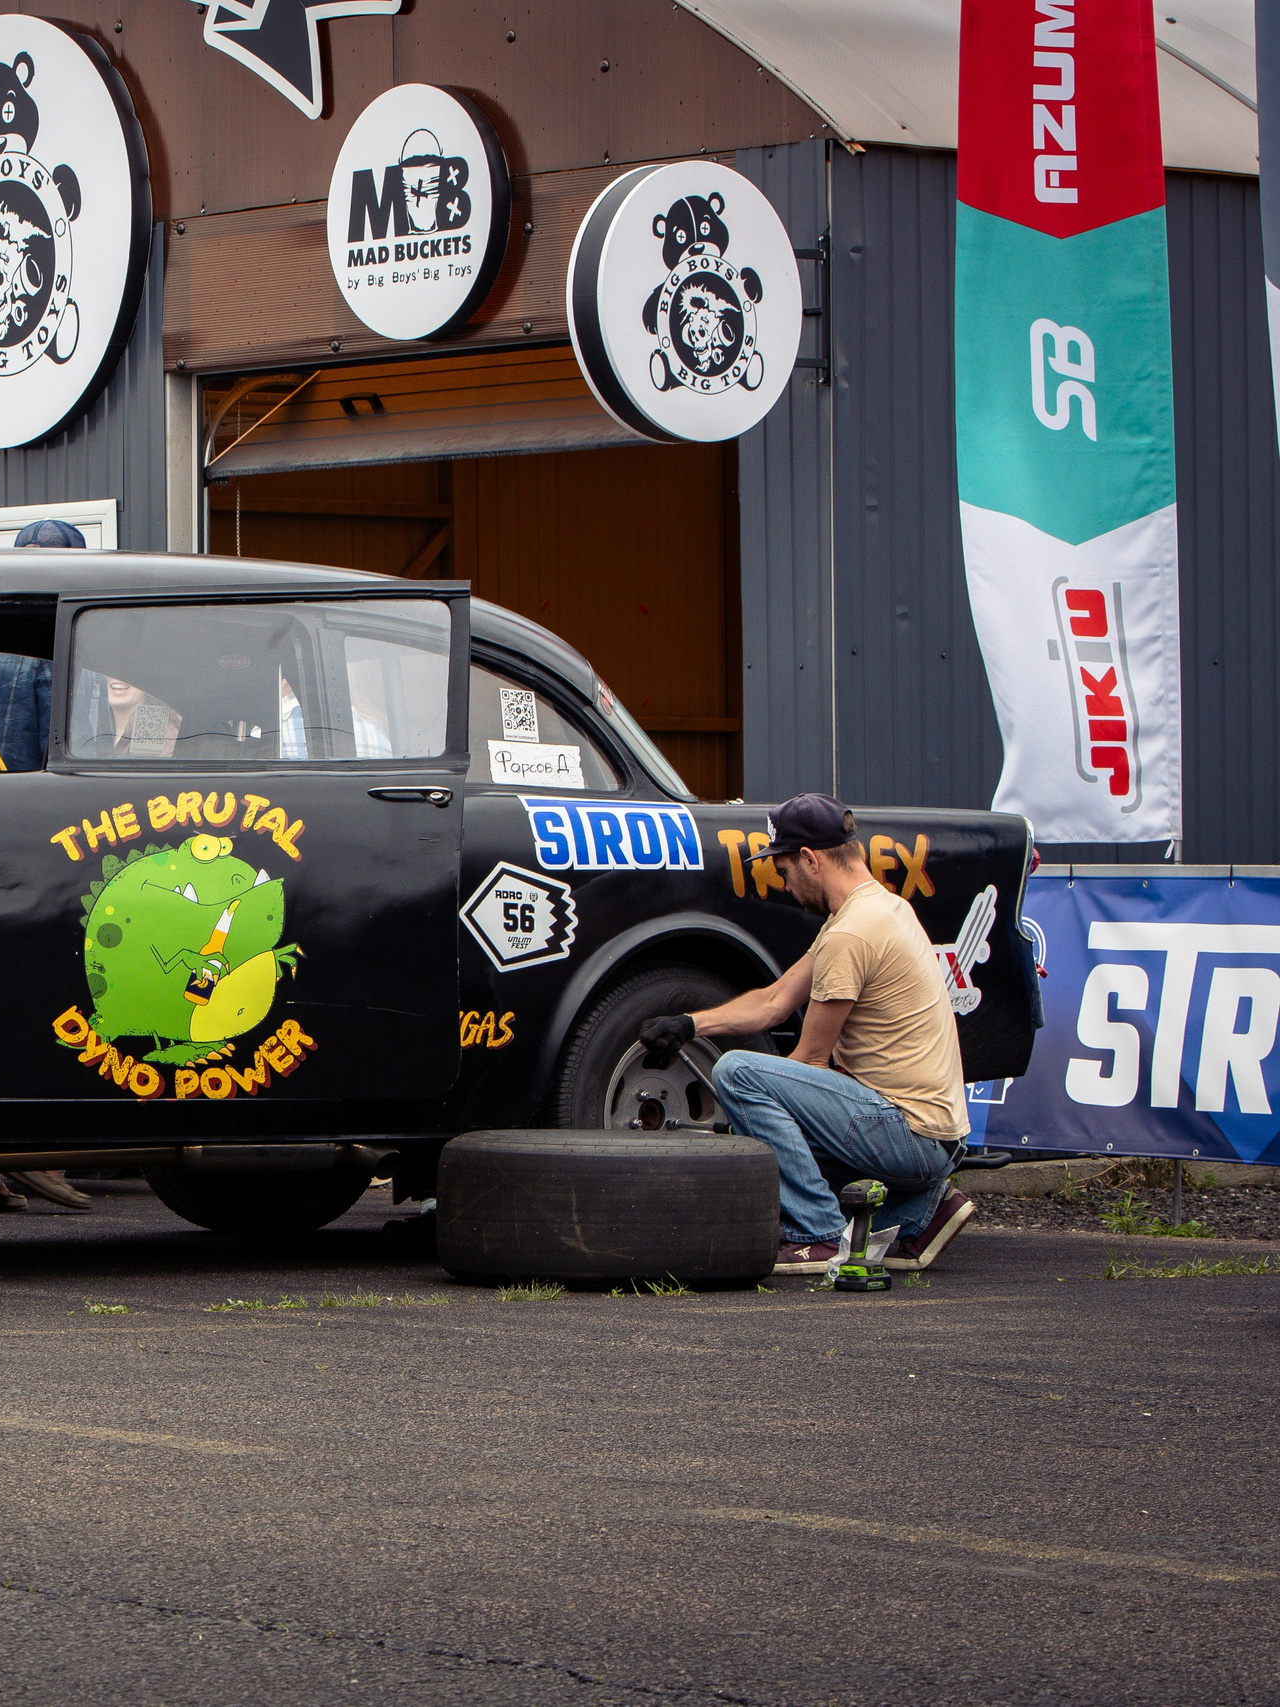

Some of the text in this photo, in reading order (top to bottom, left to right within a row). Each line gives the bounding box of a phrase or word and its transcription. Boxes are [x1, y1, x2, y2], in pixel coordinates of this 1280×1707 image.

[1033, 0, 1078, 204] AZUM
[347, 235, 472, 268] MAD BUCKETS
[347, 276, 360, 290] by
[367, 274, 385, 288] Big
[423, 267, 440, 281] Big
[448, 264, 472, 278] Toys
[659, 273, 681, 314] BIG
[21, 274, 68, 361] TOYS
[677, 334, 754, 390] BIG TOYS
[494, 750, 570, 778] Форсов Д
[50, 791, 306, 862] THE BRUTAL
[495, 890, 523, 900] RDRC
[503, 902, 535, 933] 56
[459, 1010, 516, 1050] GAS
[1065, 921, 1280, 1115] STR
[52, 1005, 318, 1100] DYNO POWER
